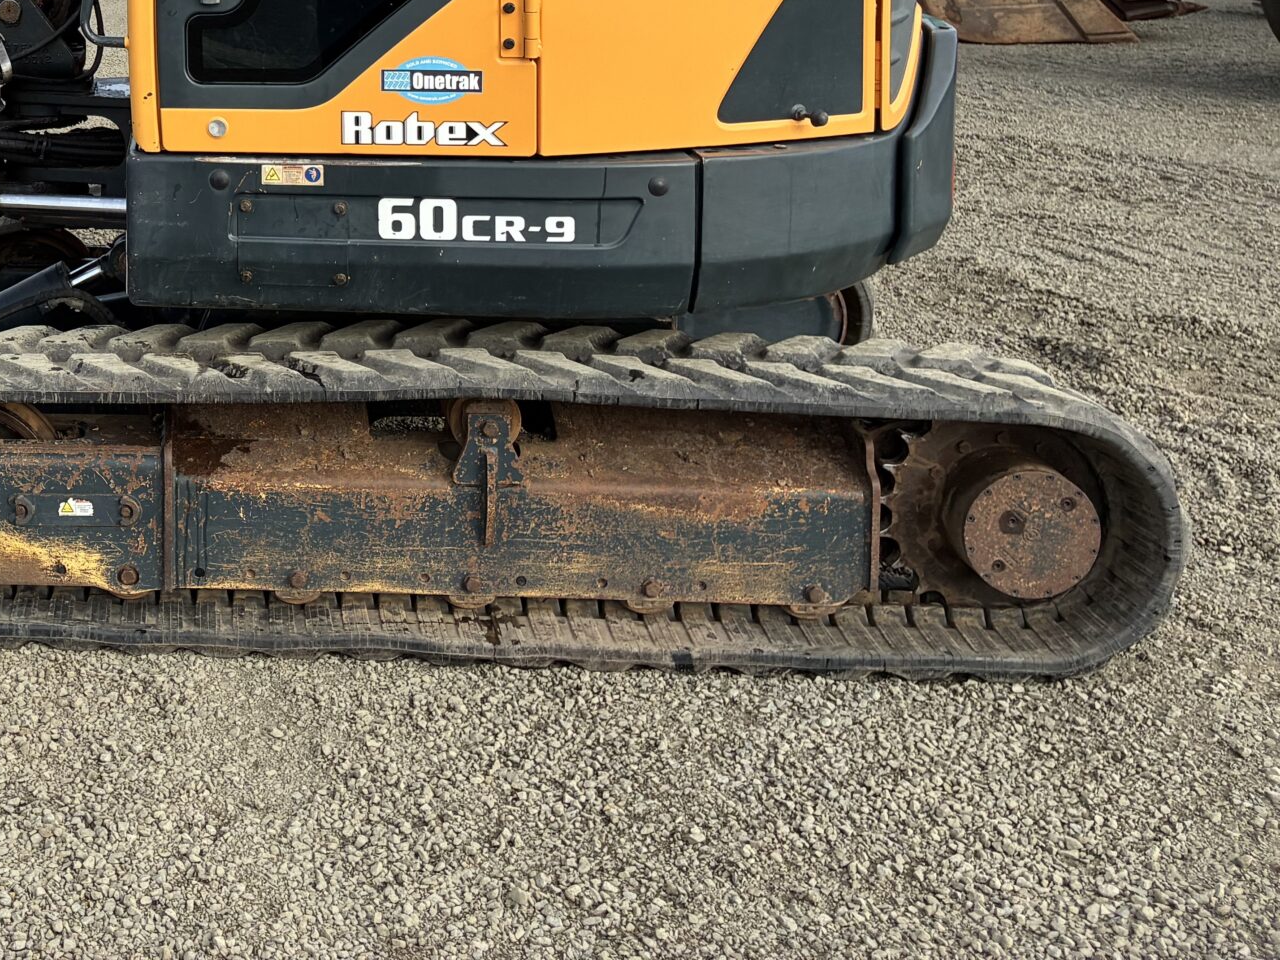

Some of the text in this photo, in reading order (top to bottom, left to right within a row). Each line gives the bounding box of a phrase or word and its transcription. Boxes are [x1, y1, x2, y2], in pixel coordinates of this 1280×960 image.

[412, 72, 480, 90] Onetrak
[340, 110, 508, 146] Robex
[377, 197, 576, 243] 60CR-9
